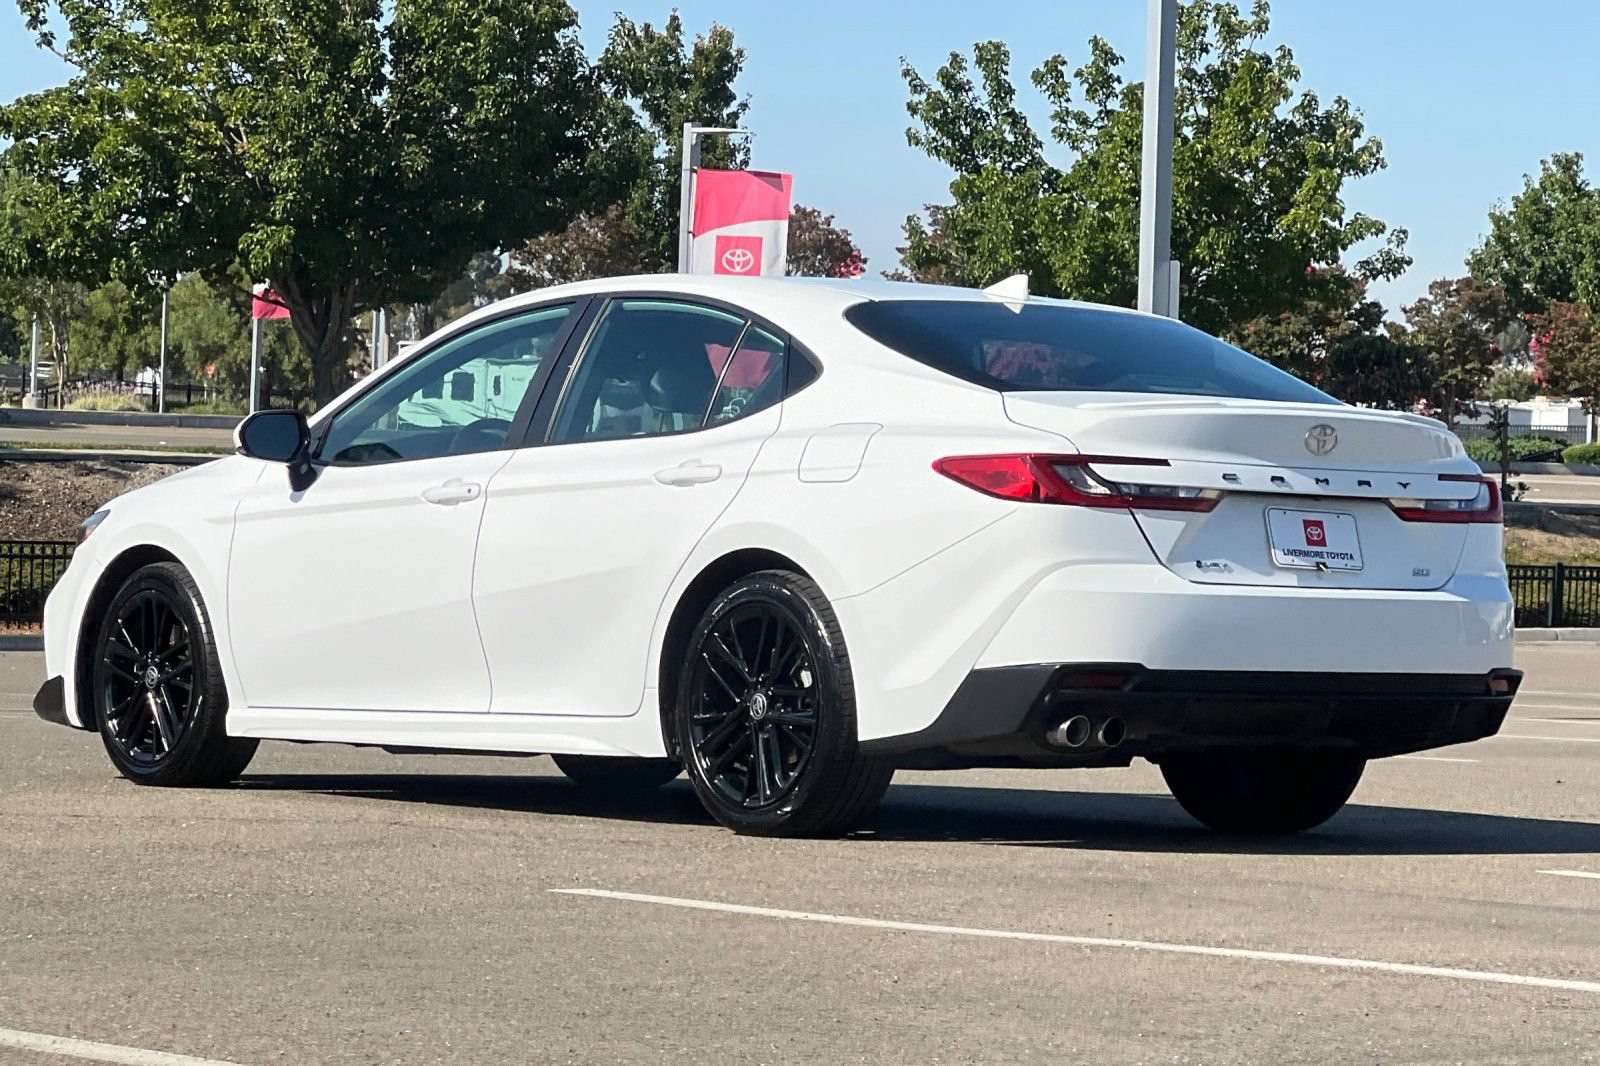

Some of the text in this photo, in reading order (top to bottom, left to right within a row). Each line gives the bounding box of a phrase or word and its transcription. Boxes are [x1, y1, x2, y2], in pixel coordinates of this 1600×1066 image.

[1222, 473, 1411, 489] CAMRY
[1282, 548, 1355, 561] LIVERMORE TOYOTA
